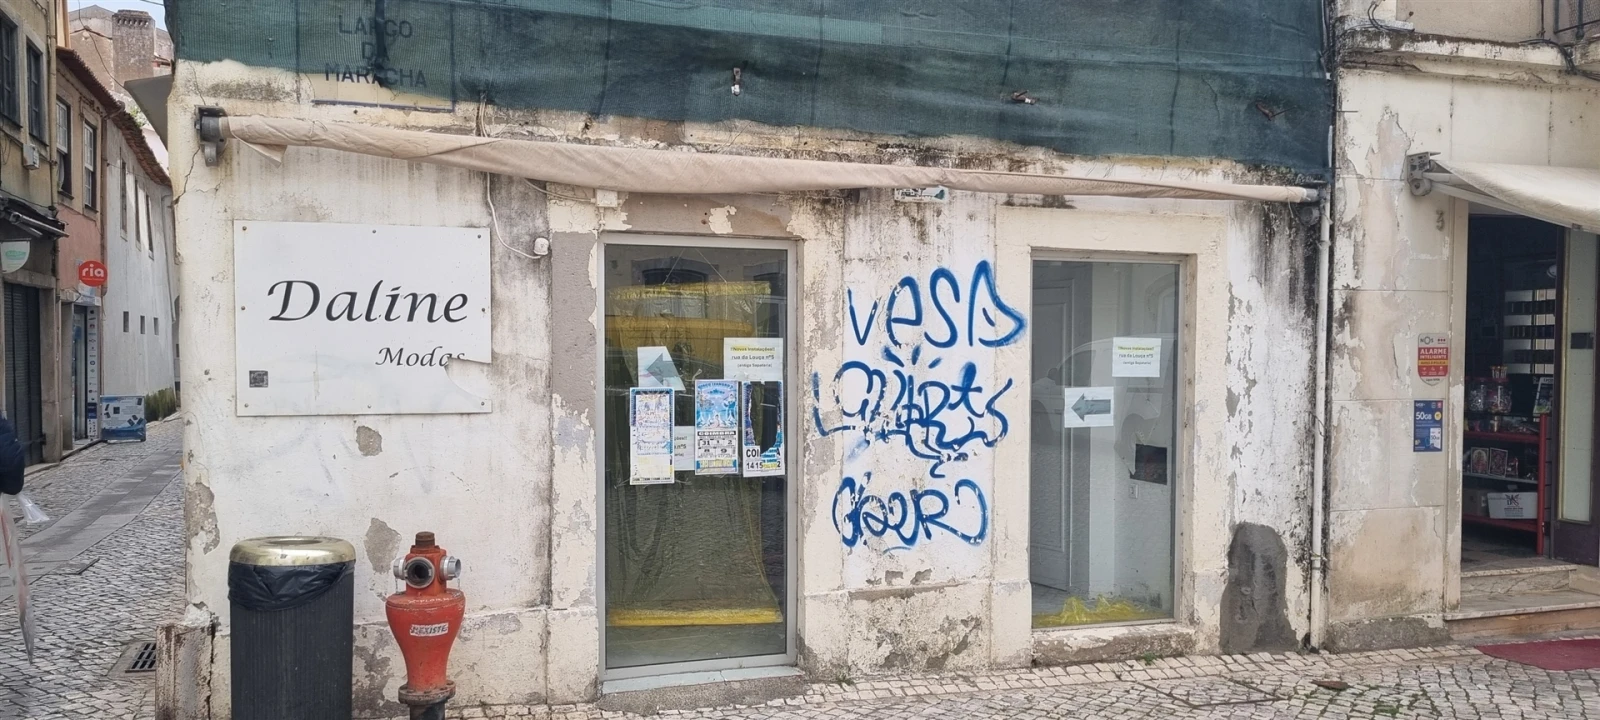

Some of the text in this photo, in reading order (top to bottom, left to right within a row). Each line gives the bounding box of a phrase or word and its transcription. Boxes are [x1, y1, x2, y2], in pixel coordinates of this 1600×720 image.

[82, 264, 105, 277] ria
[267, 280, 469, 323] Daline
[1420, 336, 1434, 345] NOS
[1416, 412, 1432, 420] 50GB
